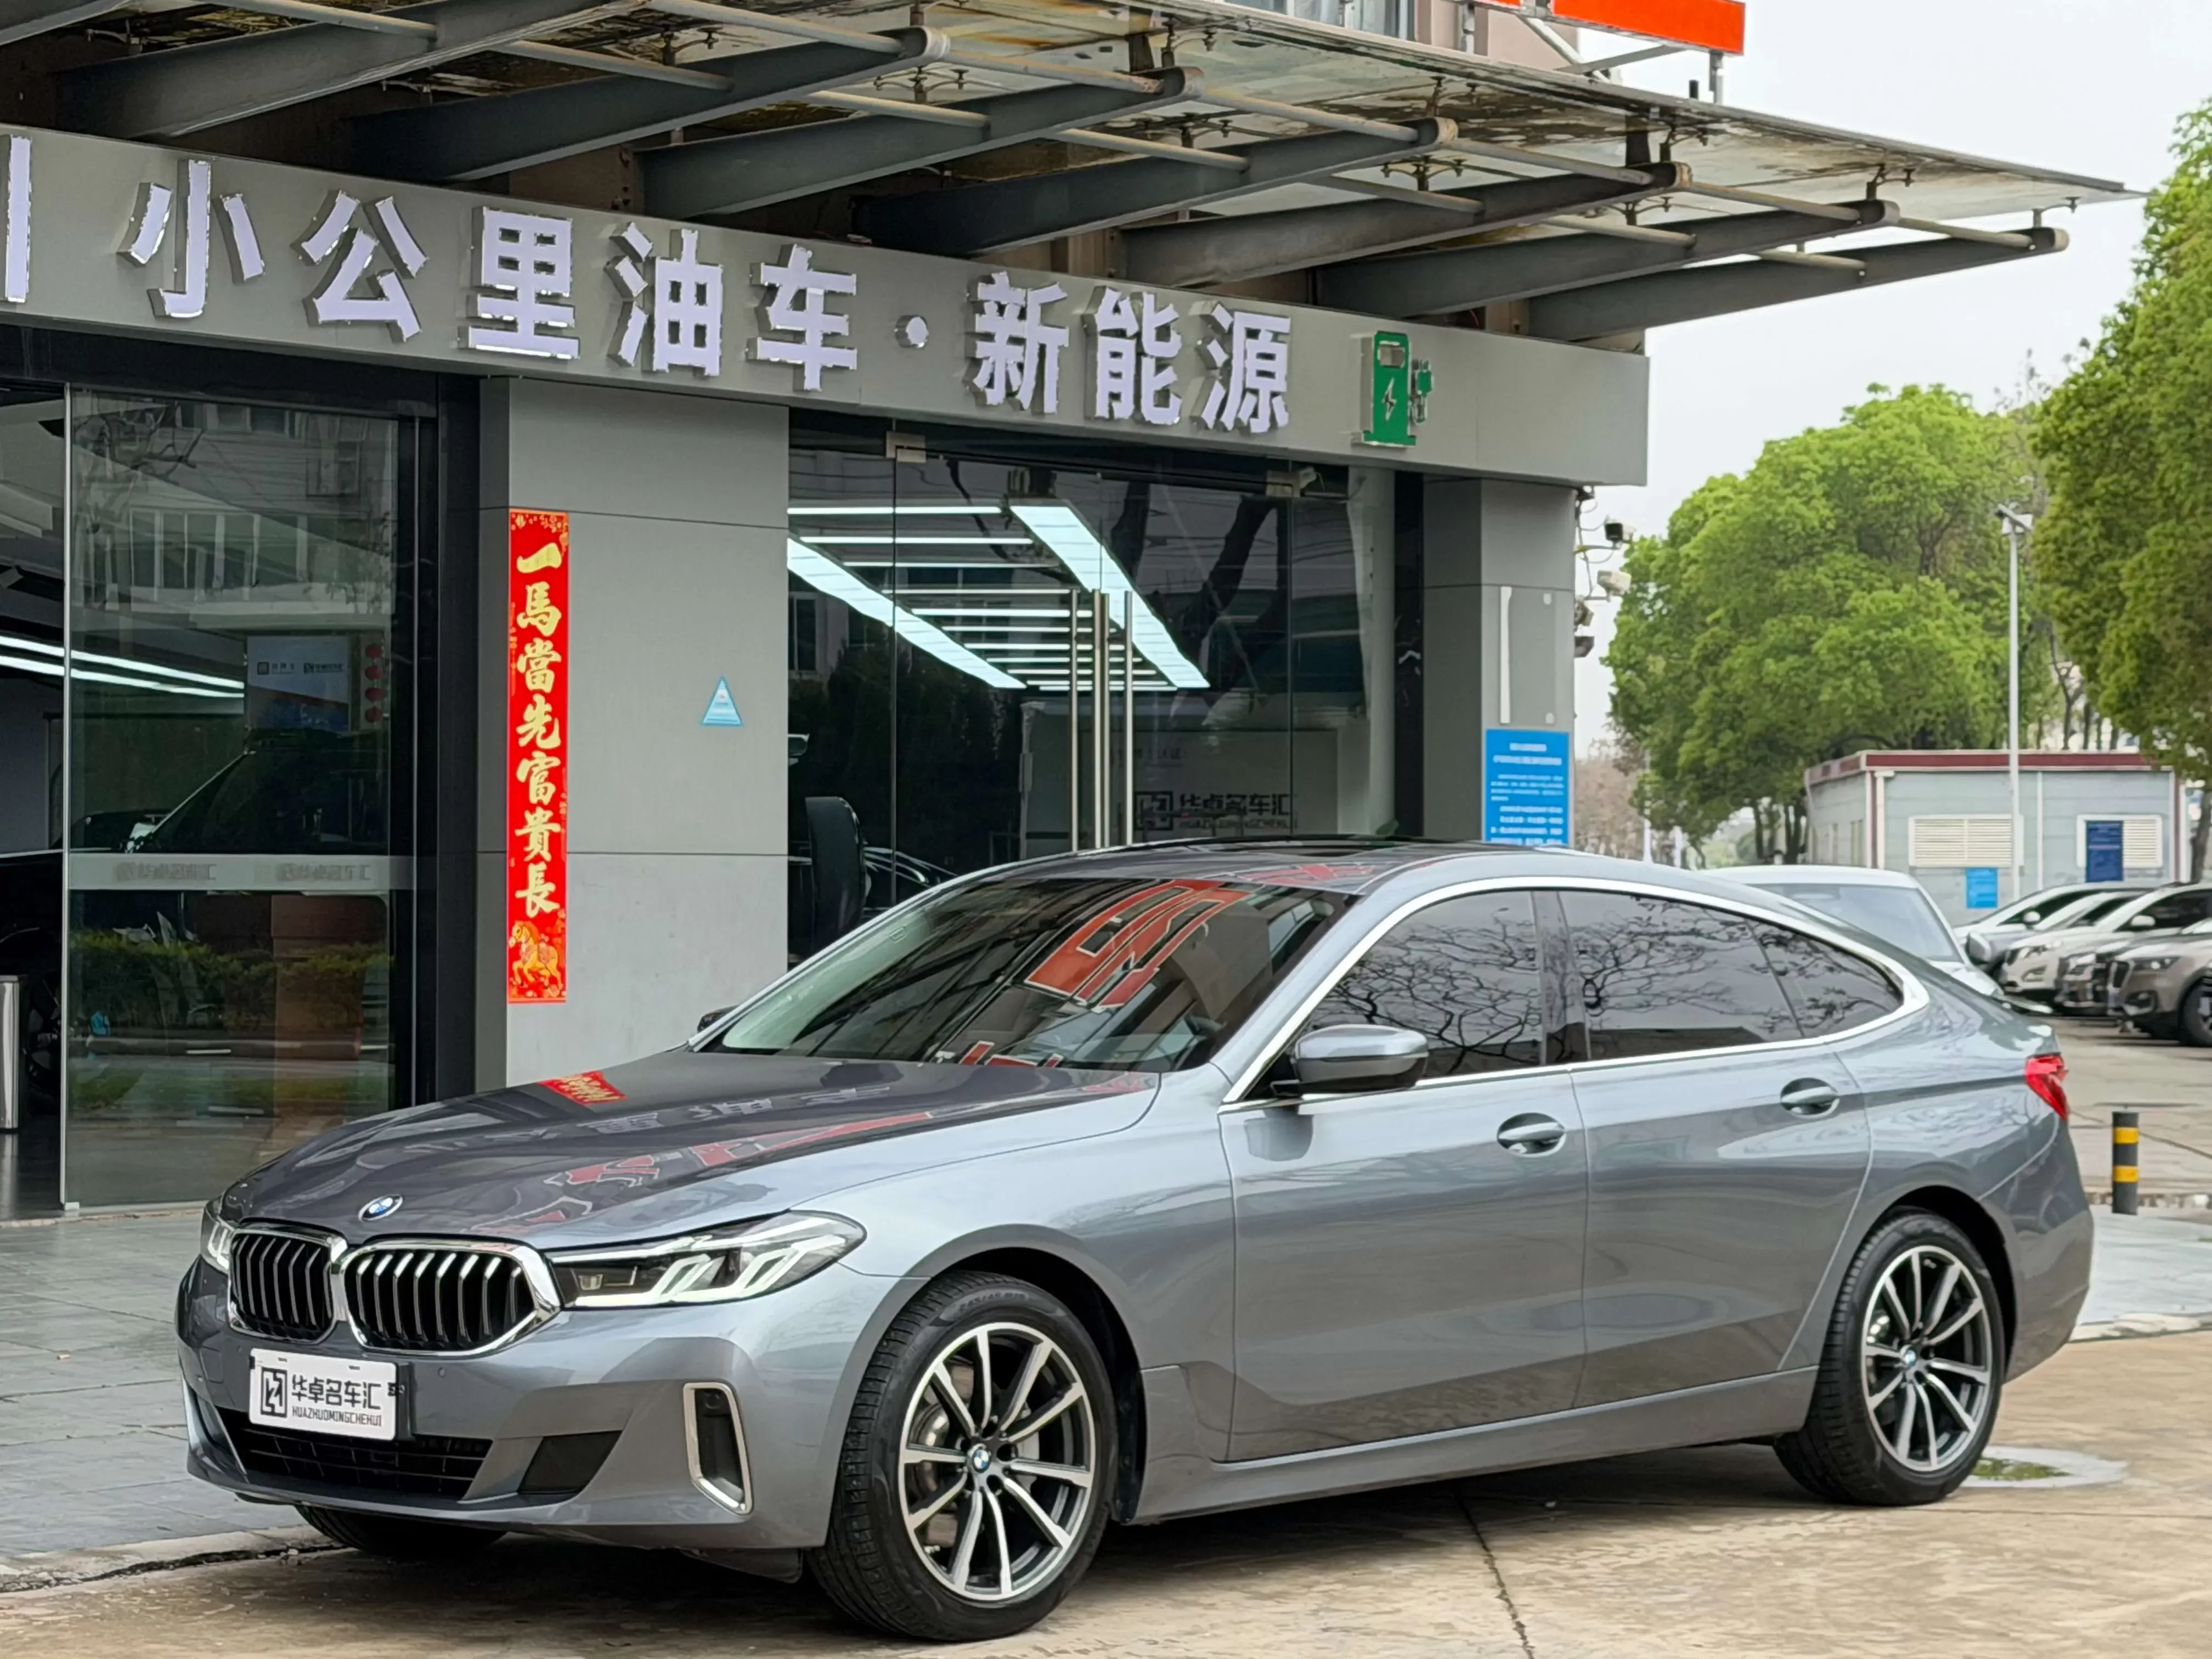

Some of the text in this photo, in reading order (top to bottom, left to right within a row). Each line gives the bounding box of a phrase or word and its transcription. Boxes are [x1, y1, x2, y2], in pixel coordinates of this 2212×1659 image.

[515, 541, 563, 919] 一馬當先富貴長
[291, 1373, 381, 1410] 华卓名车汇
